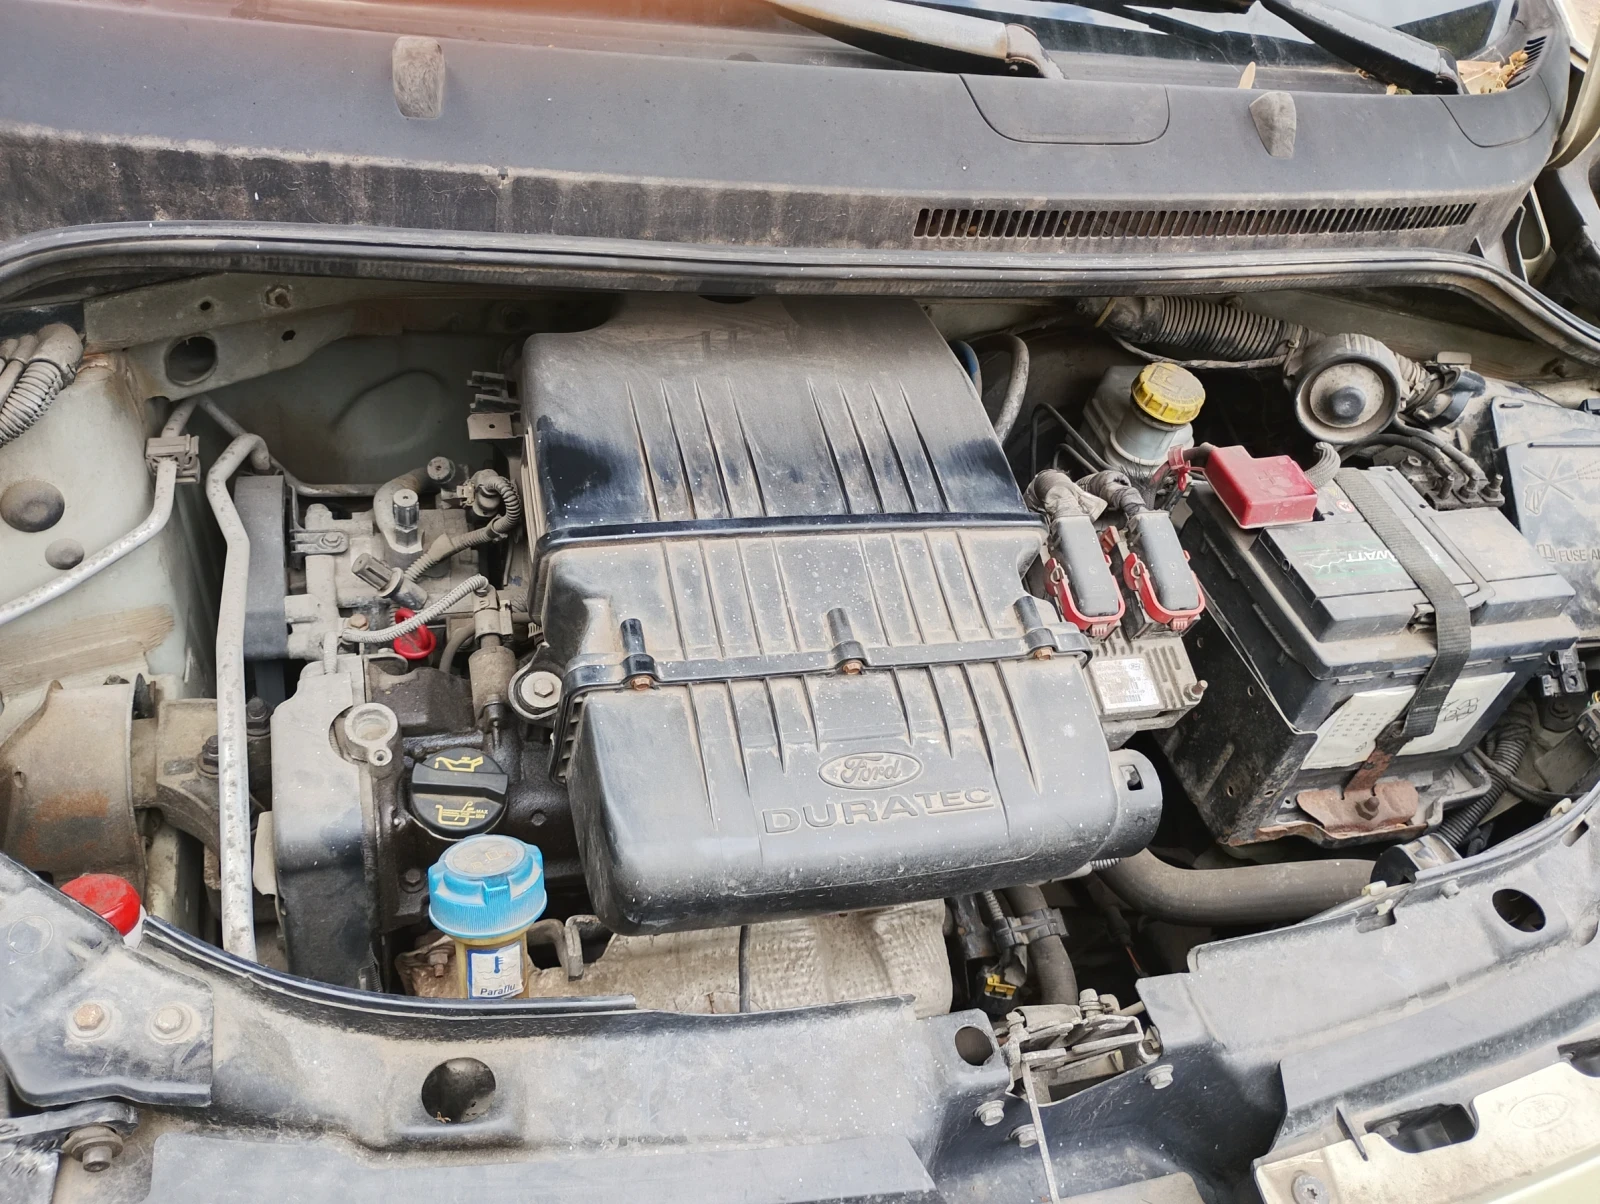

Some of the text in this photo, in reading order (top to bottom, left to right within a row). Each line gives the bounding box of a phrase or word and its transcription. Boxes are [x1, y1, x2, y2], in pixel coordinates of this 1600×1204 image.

[1558, 549, 1587, 562] FUSE
[840, 754, 902, 784] Ford
[761, 787, 993, 835] DURATEC
